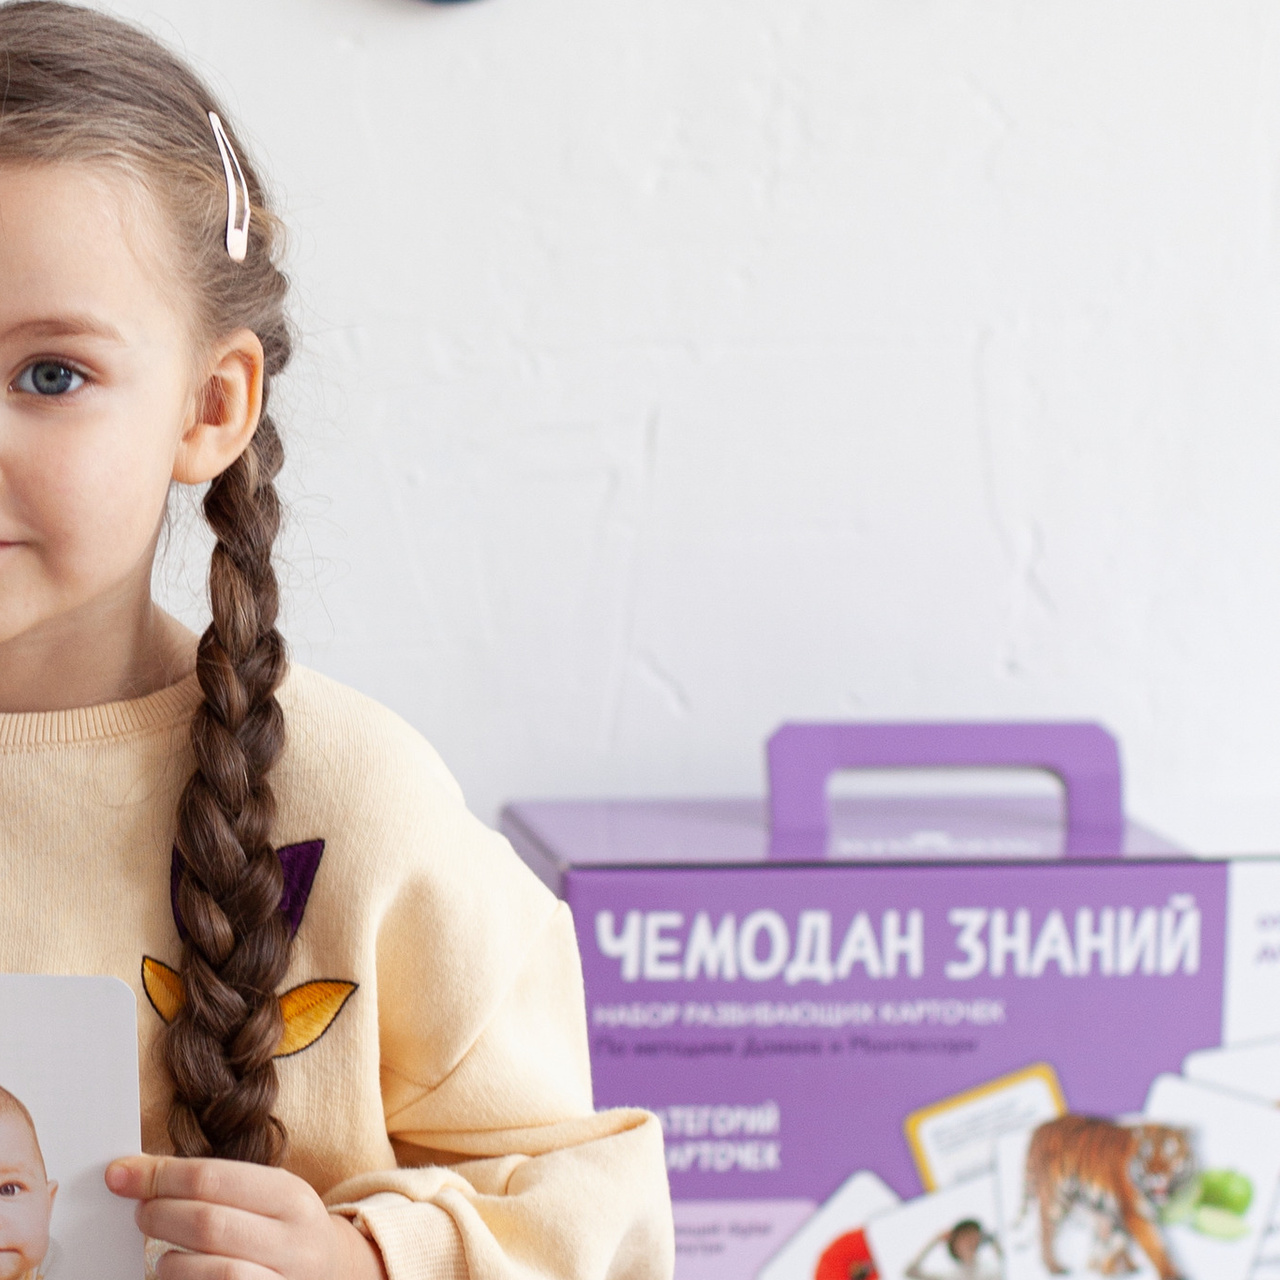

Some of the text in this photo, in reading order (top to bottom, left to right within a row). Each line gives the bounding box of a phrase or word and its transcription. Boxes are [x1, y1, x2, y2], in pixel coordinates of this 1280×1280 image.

[595, 908, 923, 986] ЧЕМОДАН
[944, 892, 1202, 982] ЗНАНИЙ
[593, 998, 1007, 1029] НАБОР РАЗВИВАЮЩИХ КАРТОЧЕК
